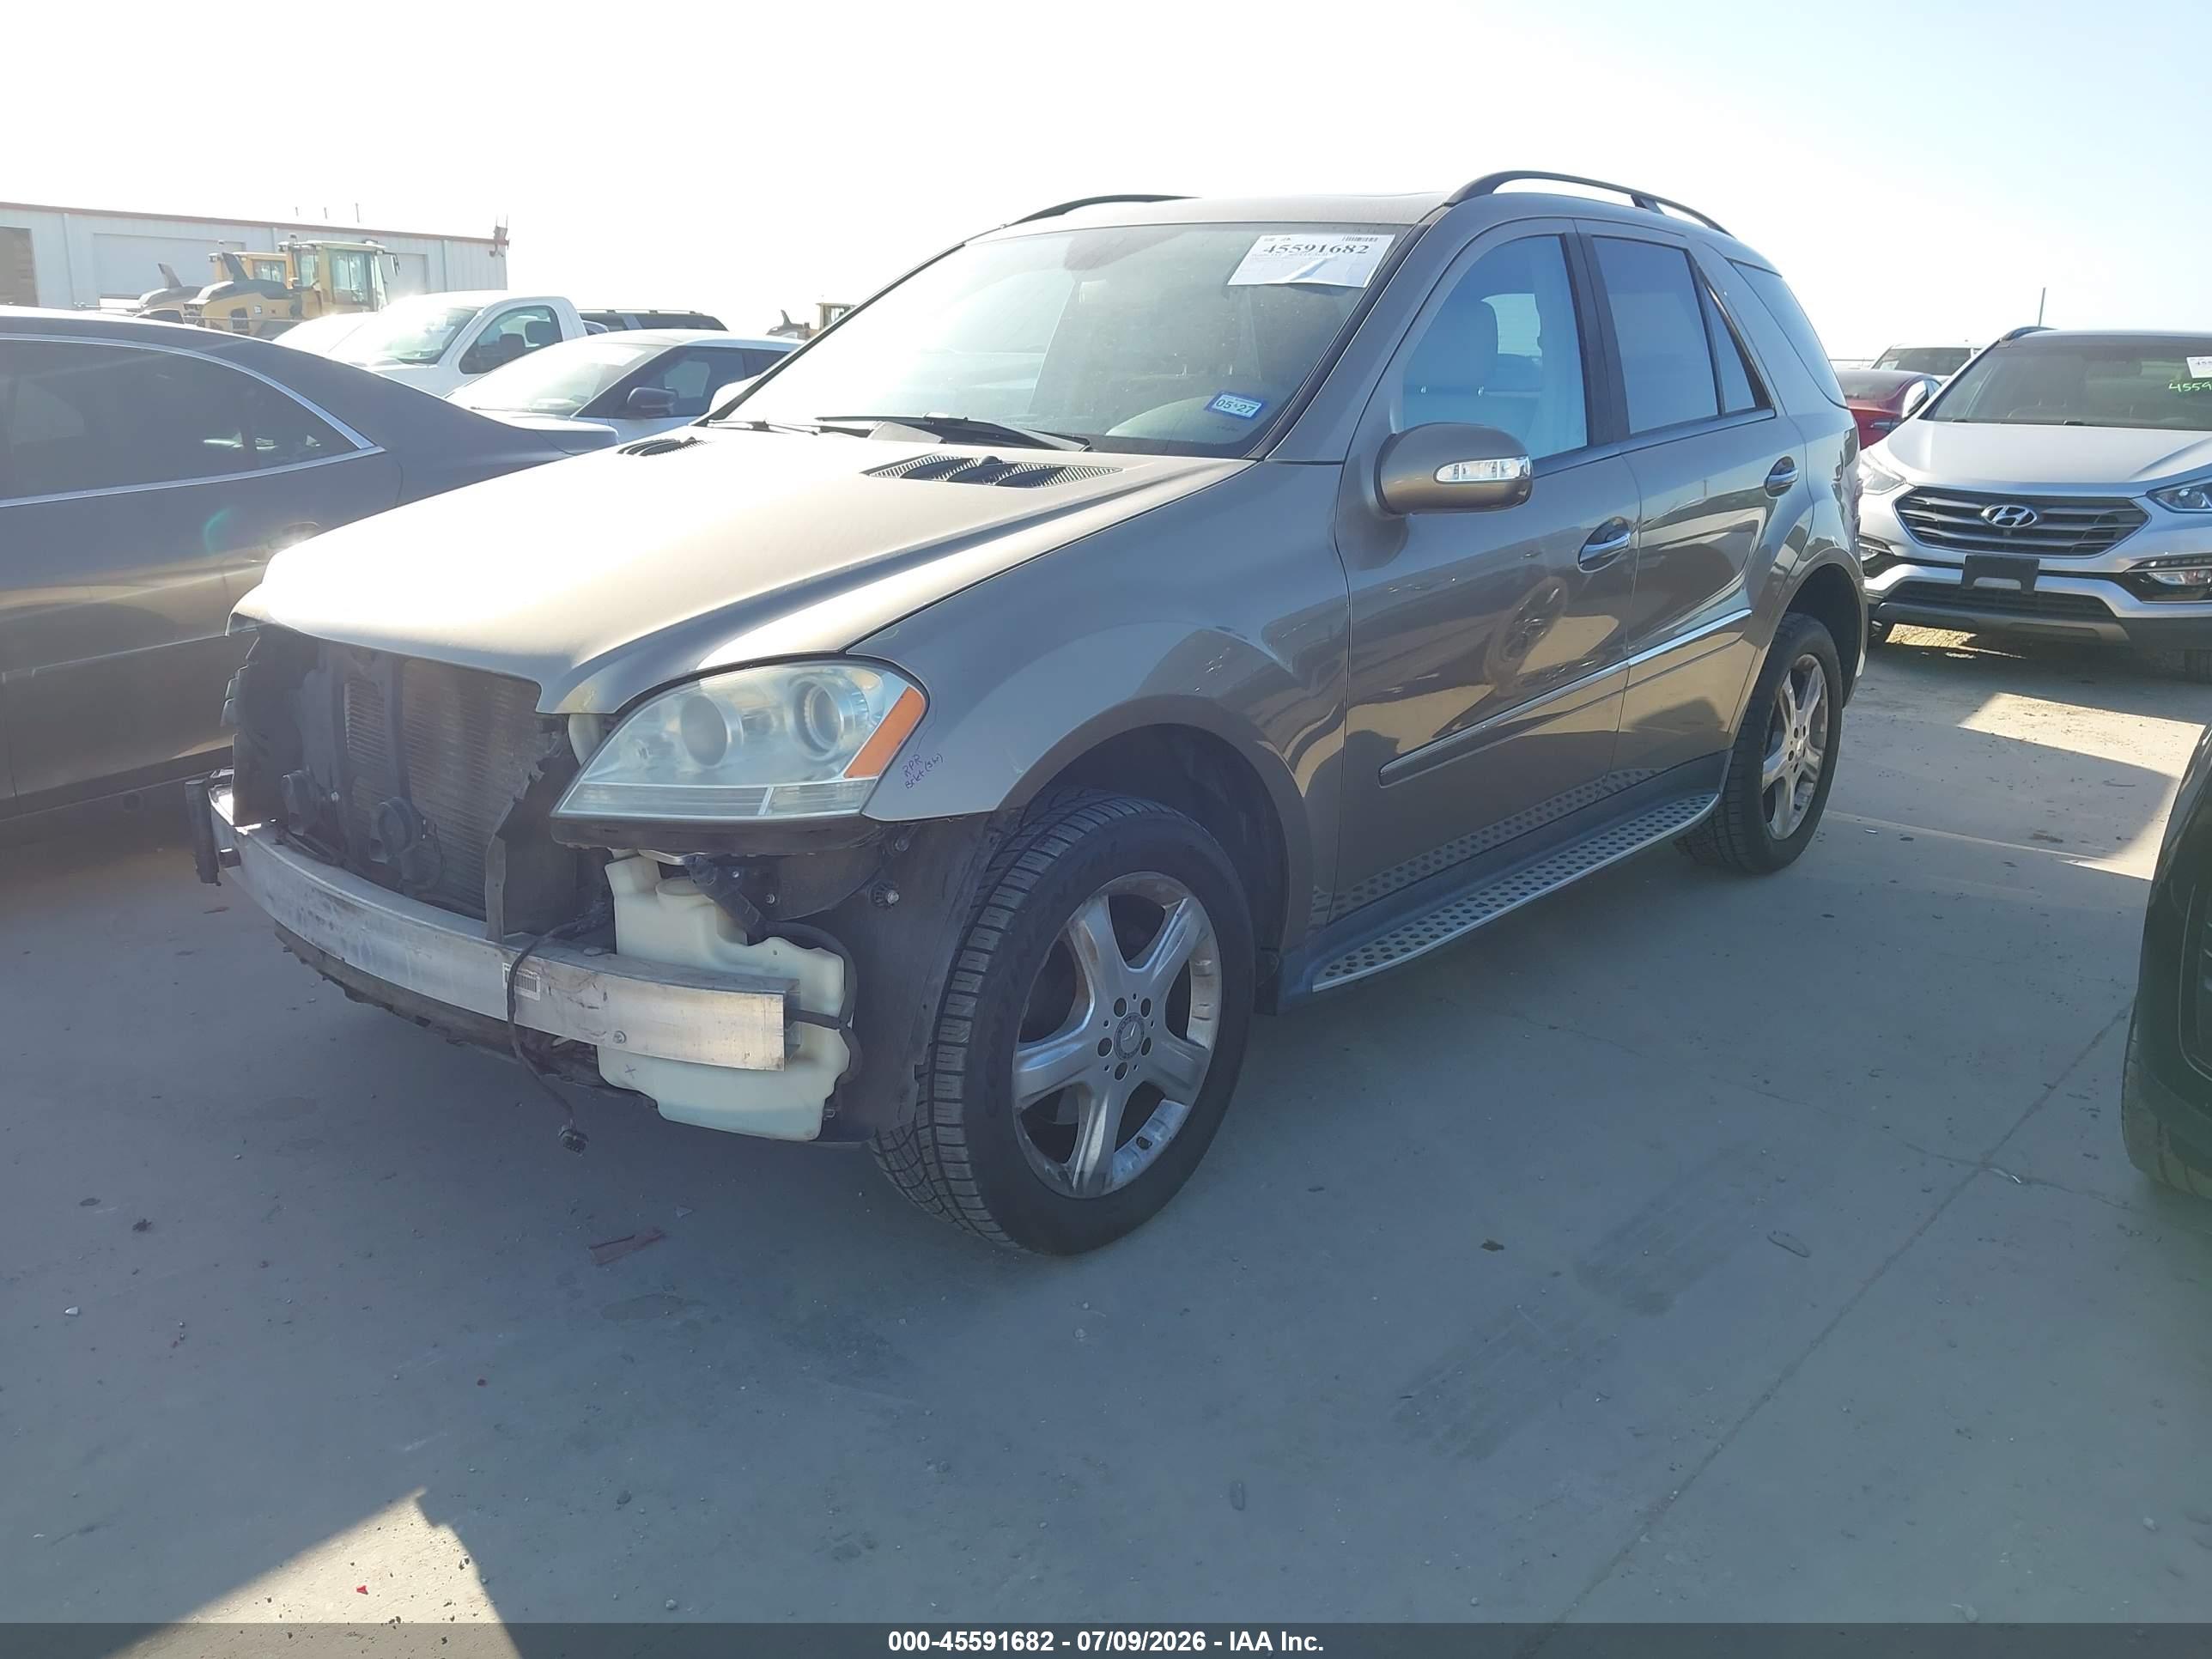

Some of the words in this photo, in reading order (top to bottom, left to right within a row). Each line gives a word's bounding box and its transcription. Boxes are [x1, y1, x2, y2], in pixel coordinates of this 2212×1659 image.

[1263, 244, 1370, 254] 45591682
[2168, 381, 2212, 392] 4559
[1215, 399, 1234, 409] 05
[1237, 404, 1256, 414] 27
